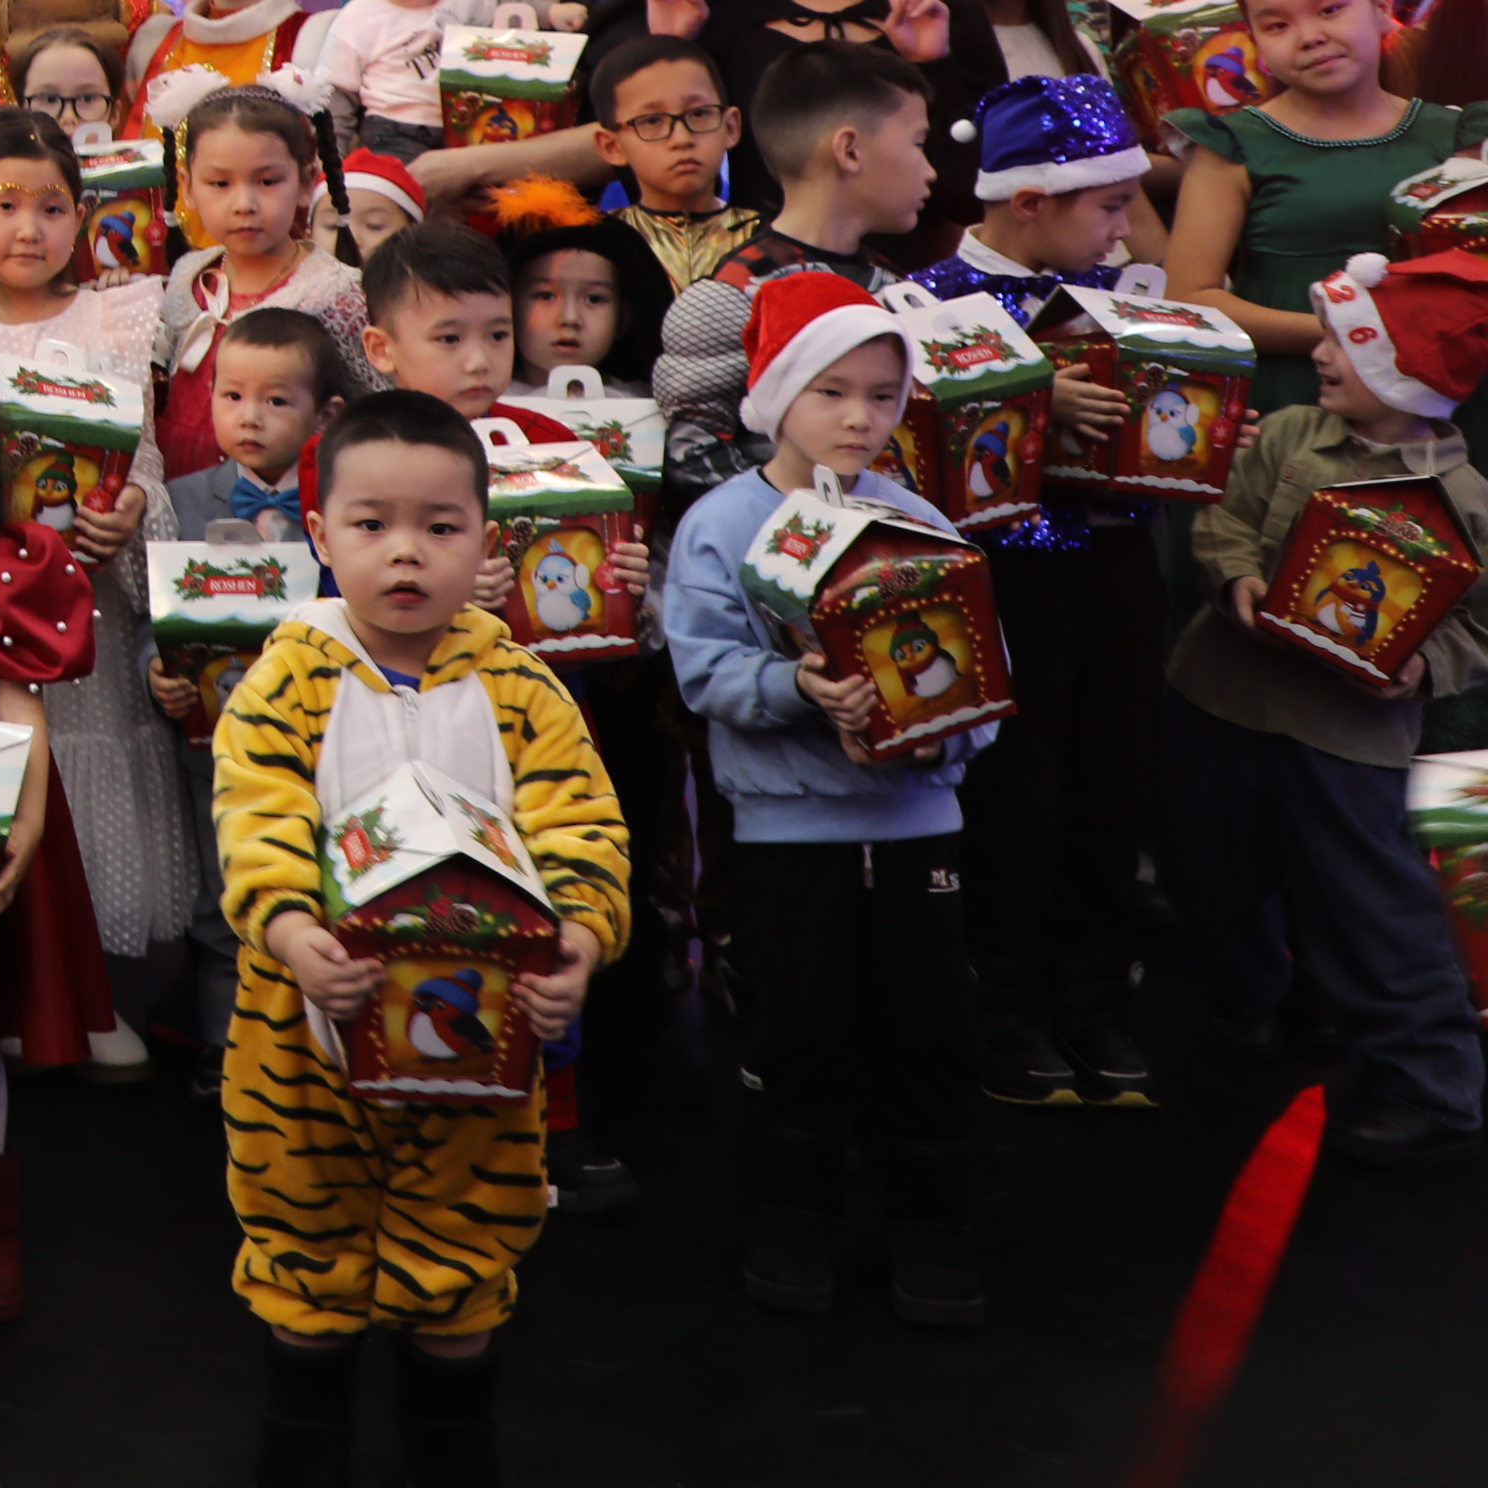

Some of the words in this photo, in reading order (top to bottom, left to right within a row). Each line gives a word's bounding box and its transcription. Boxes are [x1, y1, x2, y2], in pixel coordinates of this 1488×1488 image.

[955, 346, 993, 364] ROSHEN
[42, 384, 87, 399] ROSHEN
[209, 579, 256, 592] ROSHEN
